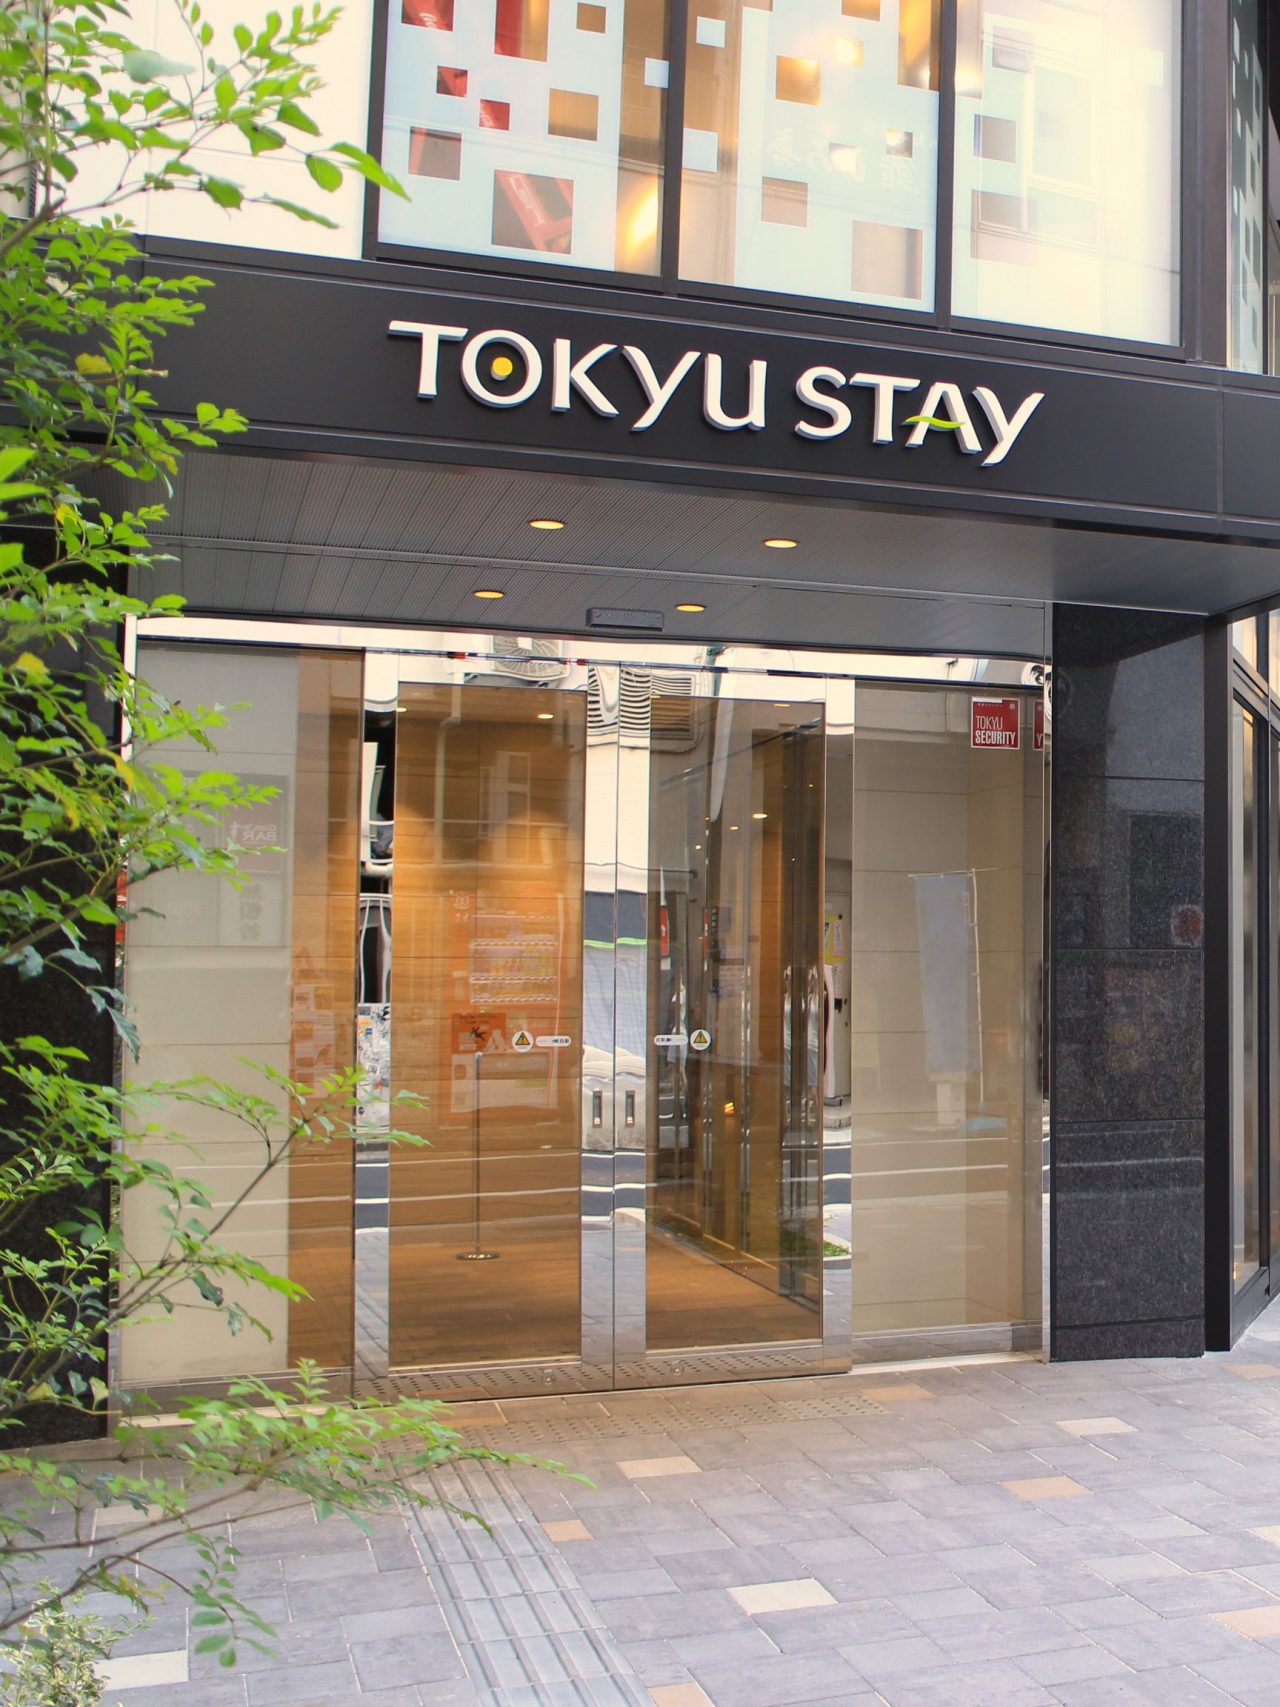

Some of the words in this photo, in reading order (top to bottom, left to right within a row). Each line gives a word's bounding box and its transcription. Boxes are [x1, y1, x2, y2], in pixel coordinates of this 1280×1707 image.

[388, 320, 767, 432] TOKYU
[794, 365, 1045, 466] STAY
[975, 715, 1003, 730] TOKYU
[975, 730, 1016, 745] SECURITY
